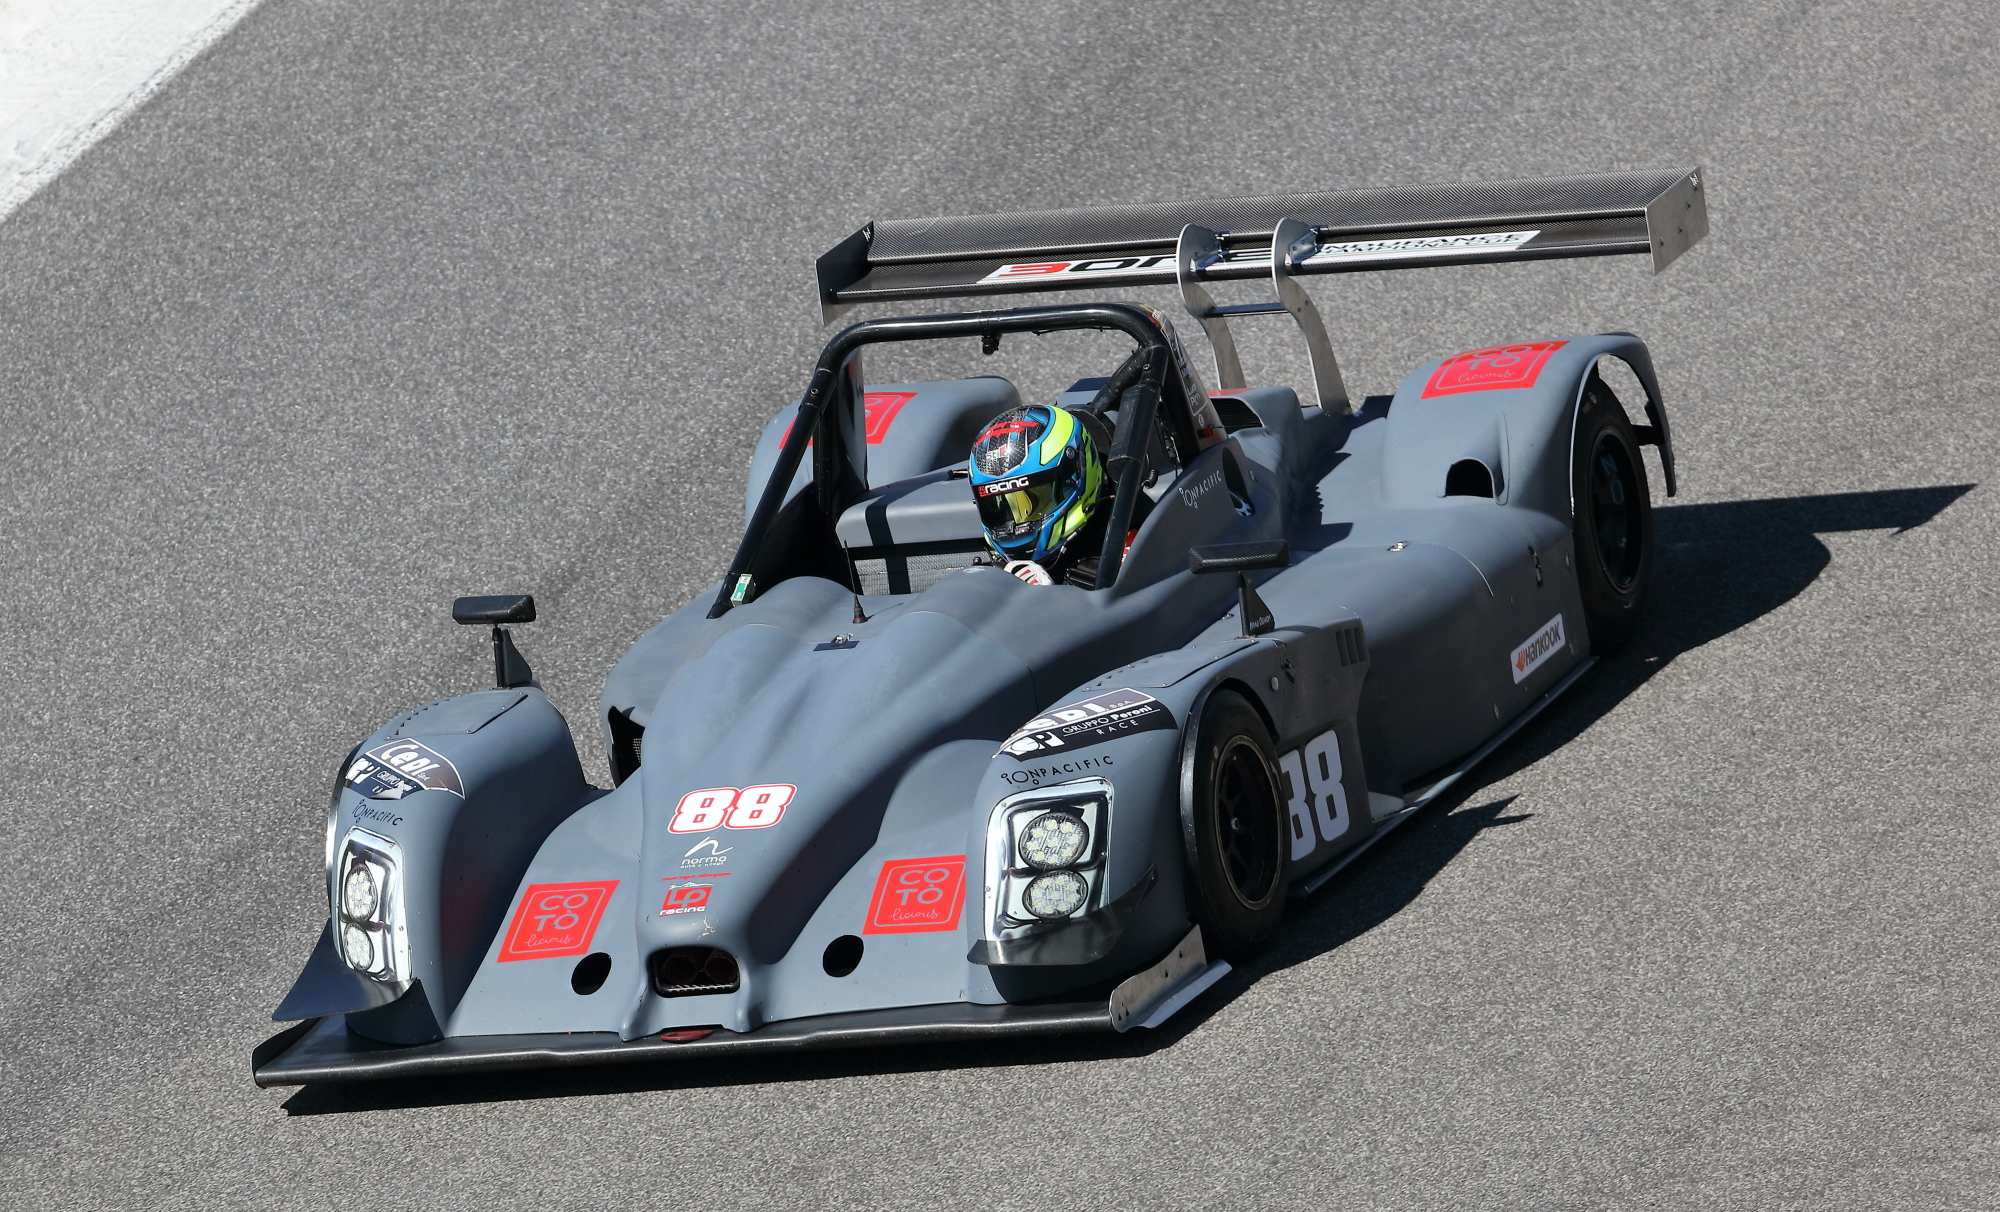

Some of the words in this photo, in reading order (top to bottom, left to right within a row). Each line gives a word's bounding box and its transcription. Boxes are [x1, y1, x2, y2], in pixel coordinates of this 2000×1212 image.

[1322, 232, 1528, 251] NDURANCE
[985, 476, 1029, 494] racing
[1063, 717, 1109, 734] GRUPPO
[1110, 705, 1153, 721] Peroni
[1096, 720, 1139, 735] RACE
[667, 783, 798, 834] 88
[681, 855, 727, 866] norma
[900, 868, 950, 885] CO
[539, 893, 589, 911] CO
[659, 906, 706, 916] racing
[889, 908, 941, 921] licious
[524, 934, 574, 948] licious
